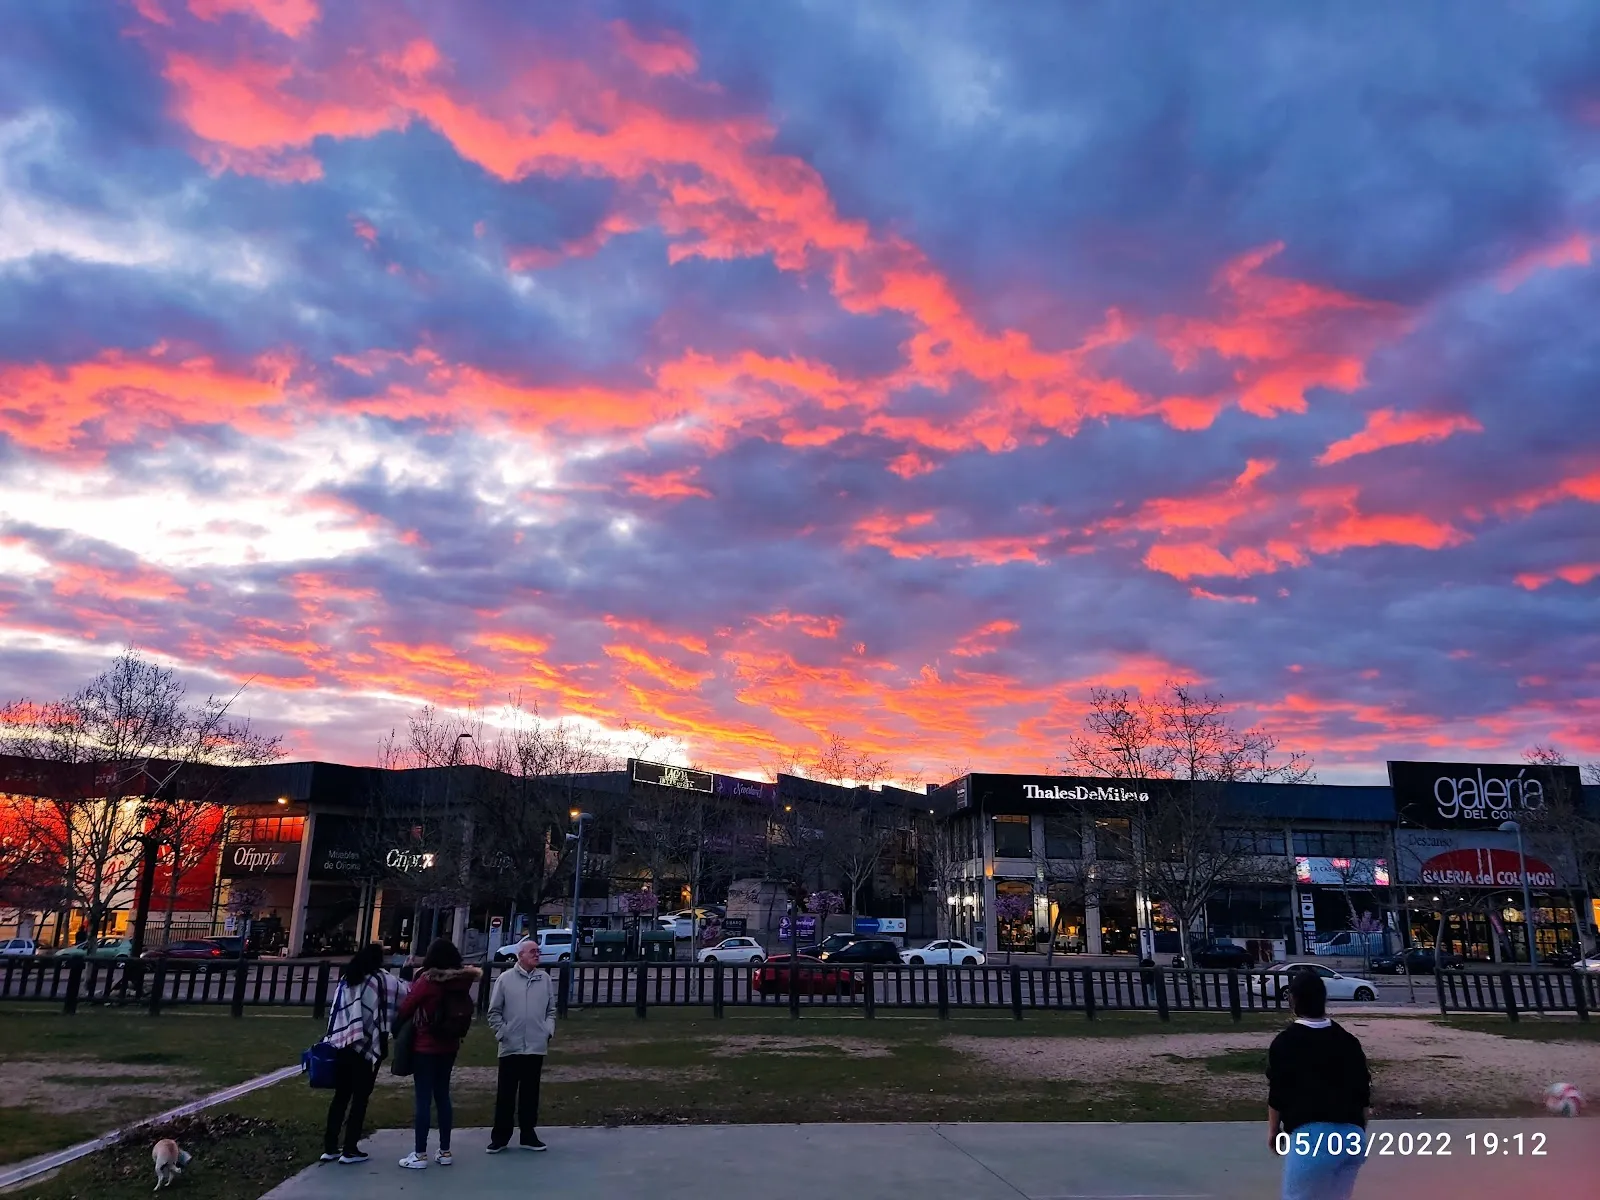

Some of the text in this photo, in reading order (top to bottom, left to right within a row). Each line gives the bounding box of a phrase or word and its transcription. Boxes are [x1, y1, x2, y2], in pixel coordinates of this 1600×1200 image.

[1434, 768, 1546, 818] galería
[1464, 810, 1488, 819] DEL
[324, 861, 334, 870] de
[1423, 848, 1556, 886] GALERIA del COLHON
